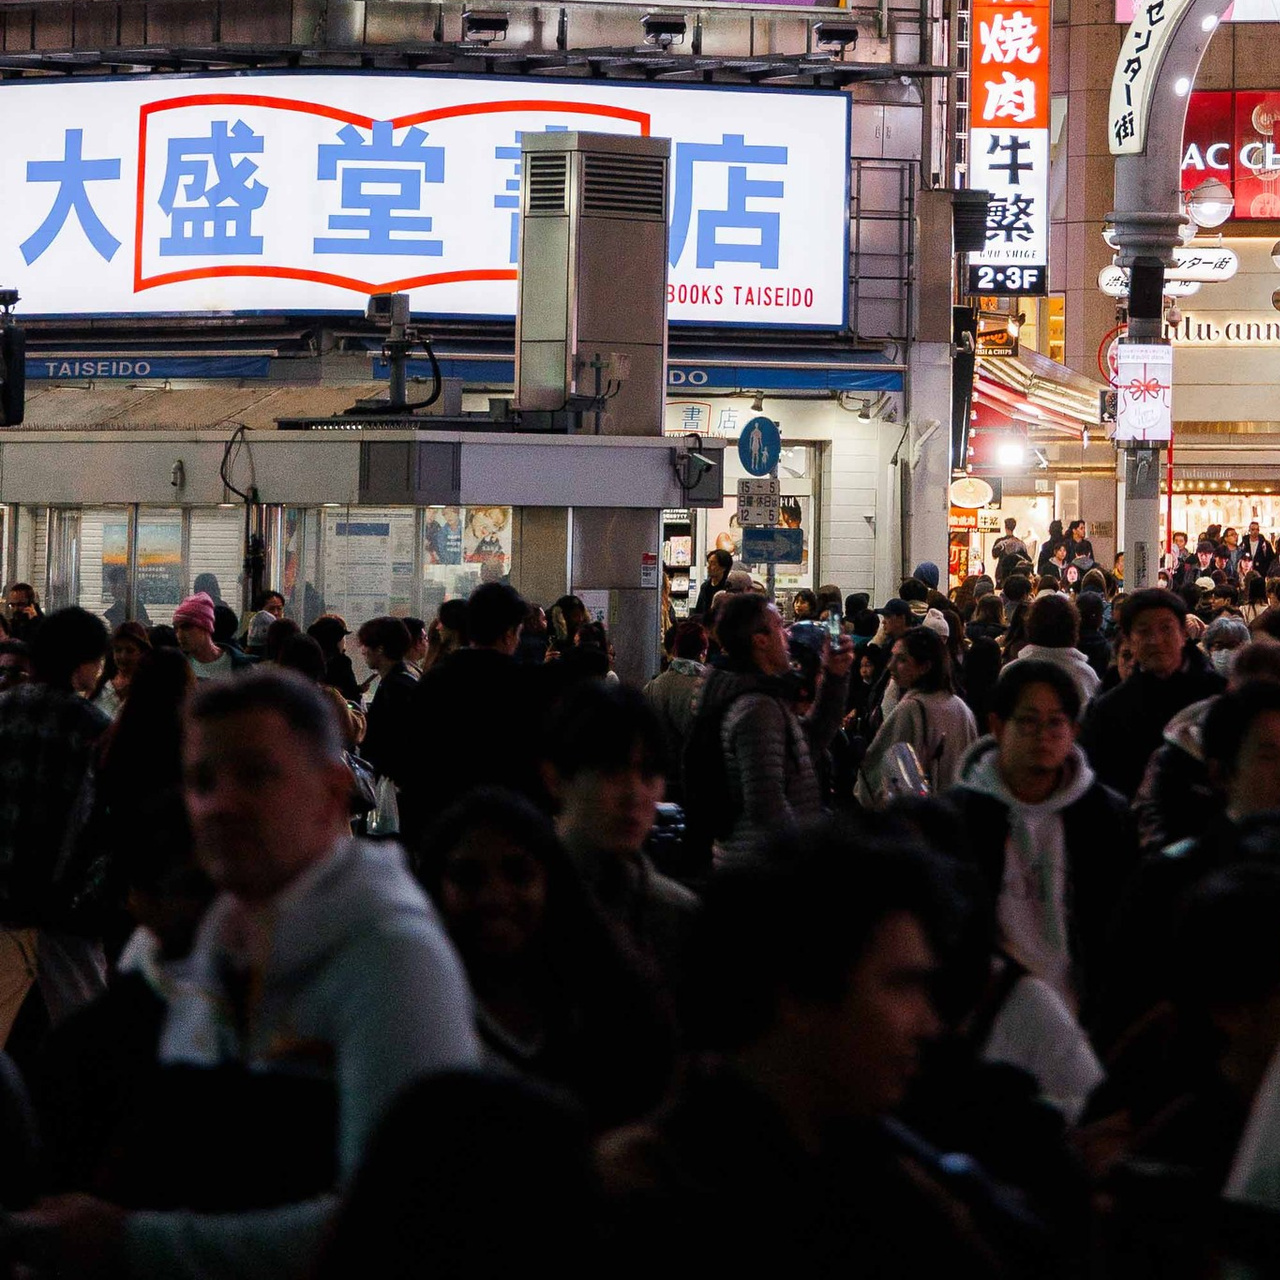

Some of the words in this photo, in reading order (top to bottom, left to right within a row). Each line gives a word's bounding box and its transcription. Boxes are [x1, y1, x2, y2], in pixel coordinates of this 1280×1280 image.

[19, 119, 789, 269] 大盛堂店
[667, 283, 723, 306] BOOKS
[733, 285, 814, 308] TAISEIDO
[45, 361, 151, 376] TAISEIDO
[741, 481, 750, 493] 15
[769, 481, 775, 493] 5
[740, 509, 750, 521] 12
[768, 509, 775, 521] 5
